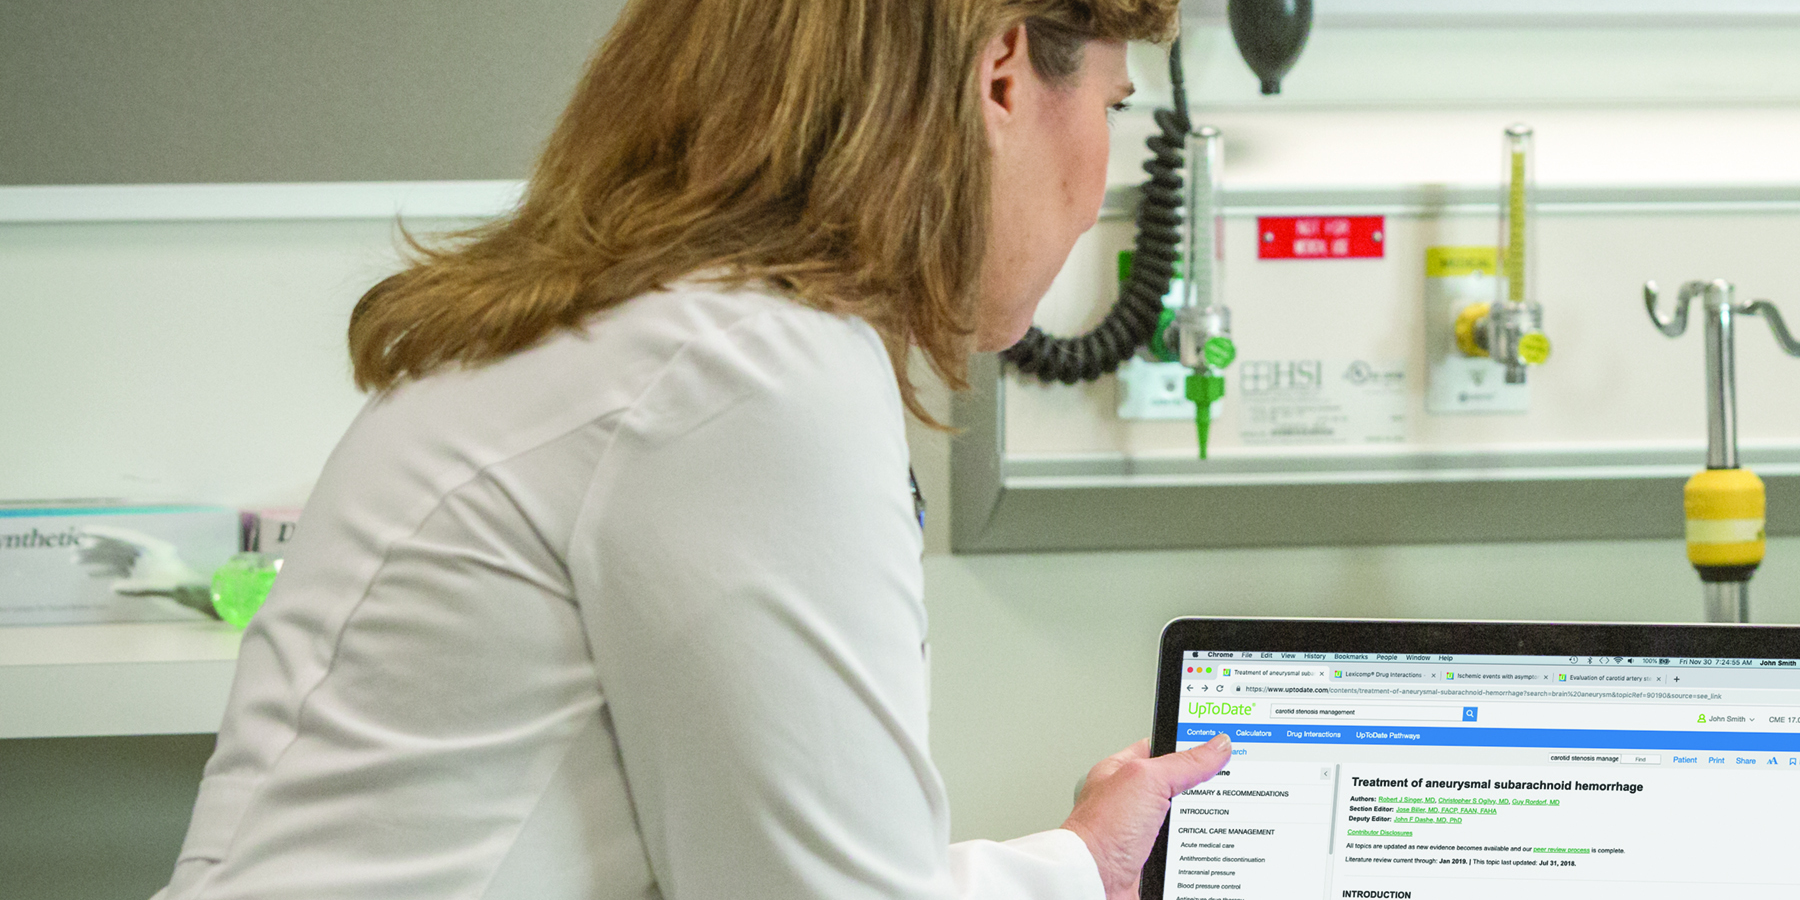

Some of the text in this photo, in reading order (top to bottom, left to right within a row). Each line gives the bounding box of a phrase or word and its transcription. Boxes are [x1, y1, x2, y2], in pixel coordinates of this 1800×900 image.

[1389, 732, 1420, 740] Pathways
[1352, 777, 1643, 793] Treatment of aneurysmal subarachnoid hemorrhage
[1342, 890, 1411, 899] INTRODUCTION
